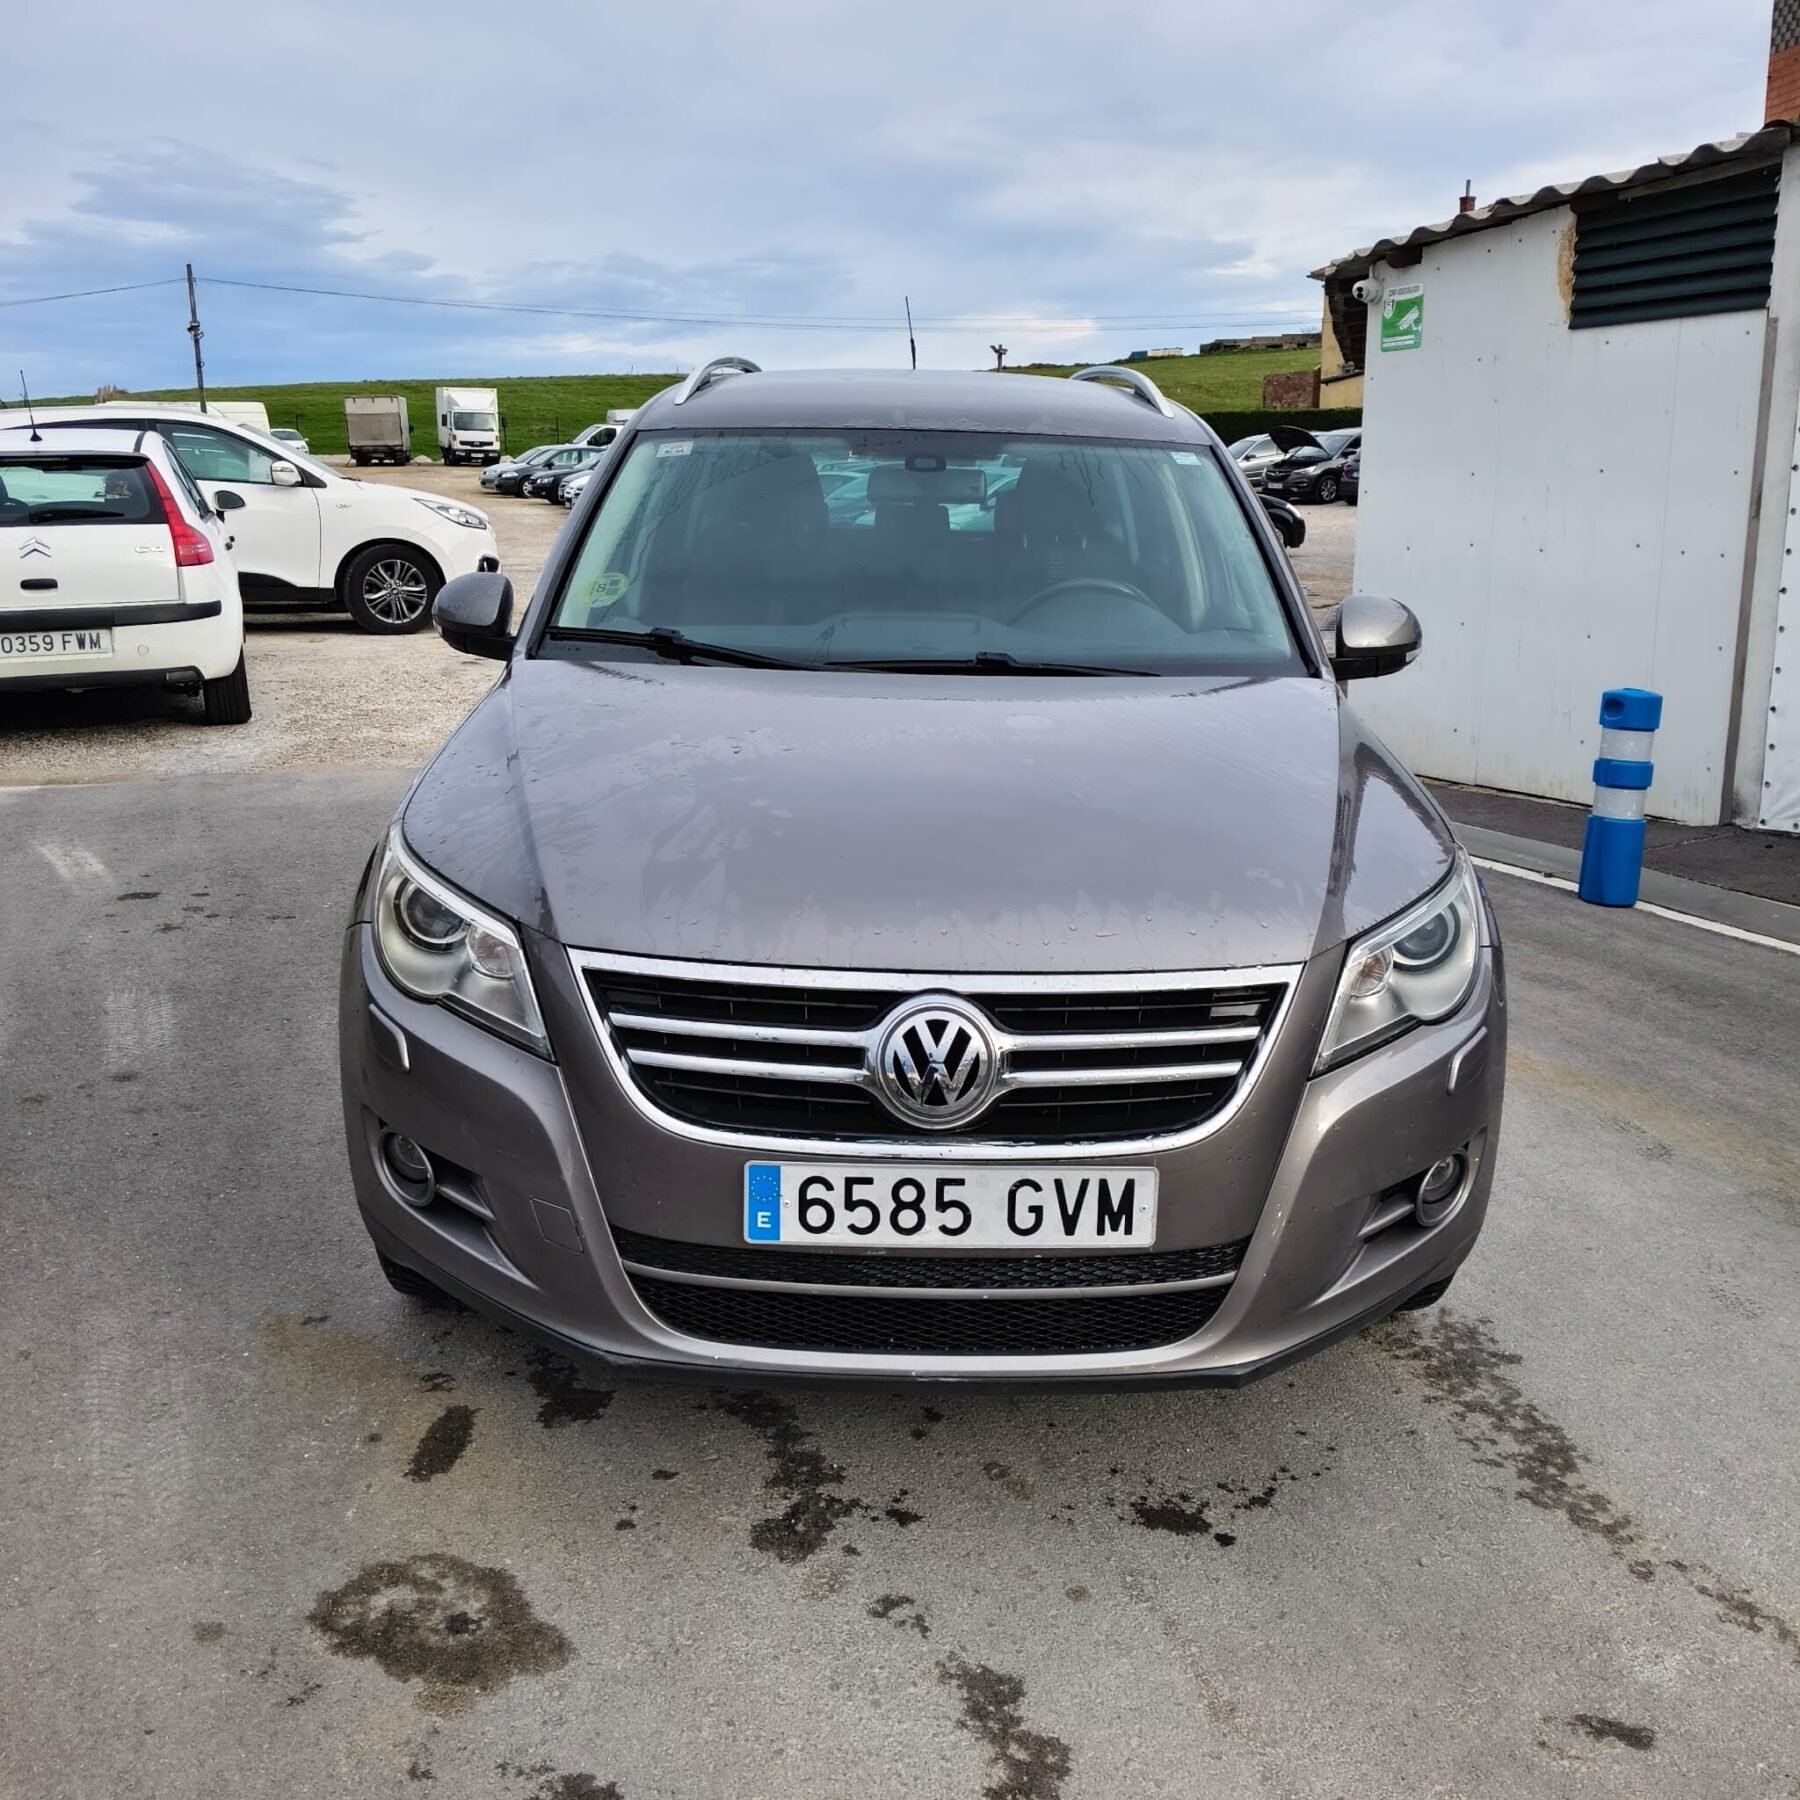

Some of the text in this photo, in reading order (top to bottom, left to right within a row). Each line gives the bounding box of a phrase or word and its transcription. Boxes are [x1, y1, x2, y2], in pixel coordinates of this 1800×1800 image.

[1, 632, 101, 654] 0359 FWM
[756, 1175, 1136, 1237] E 6585 GVM
